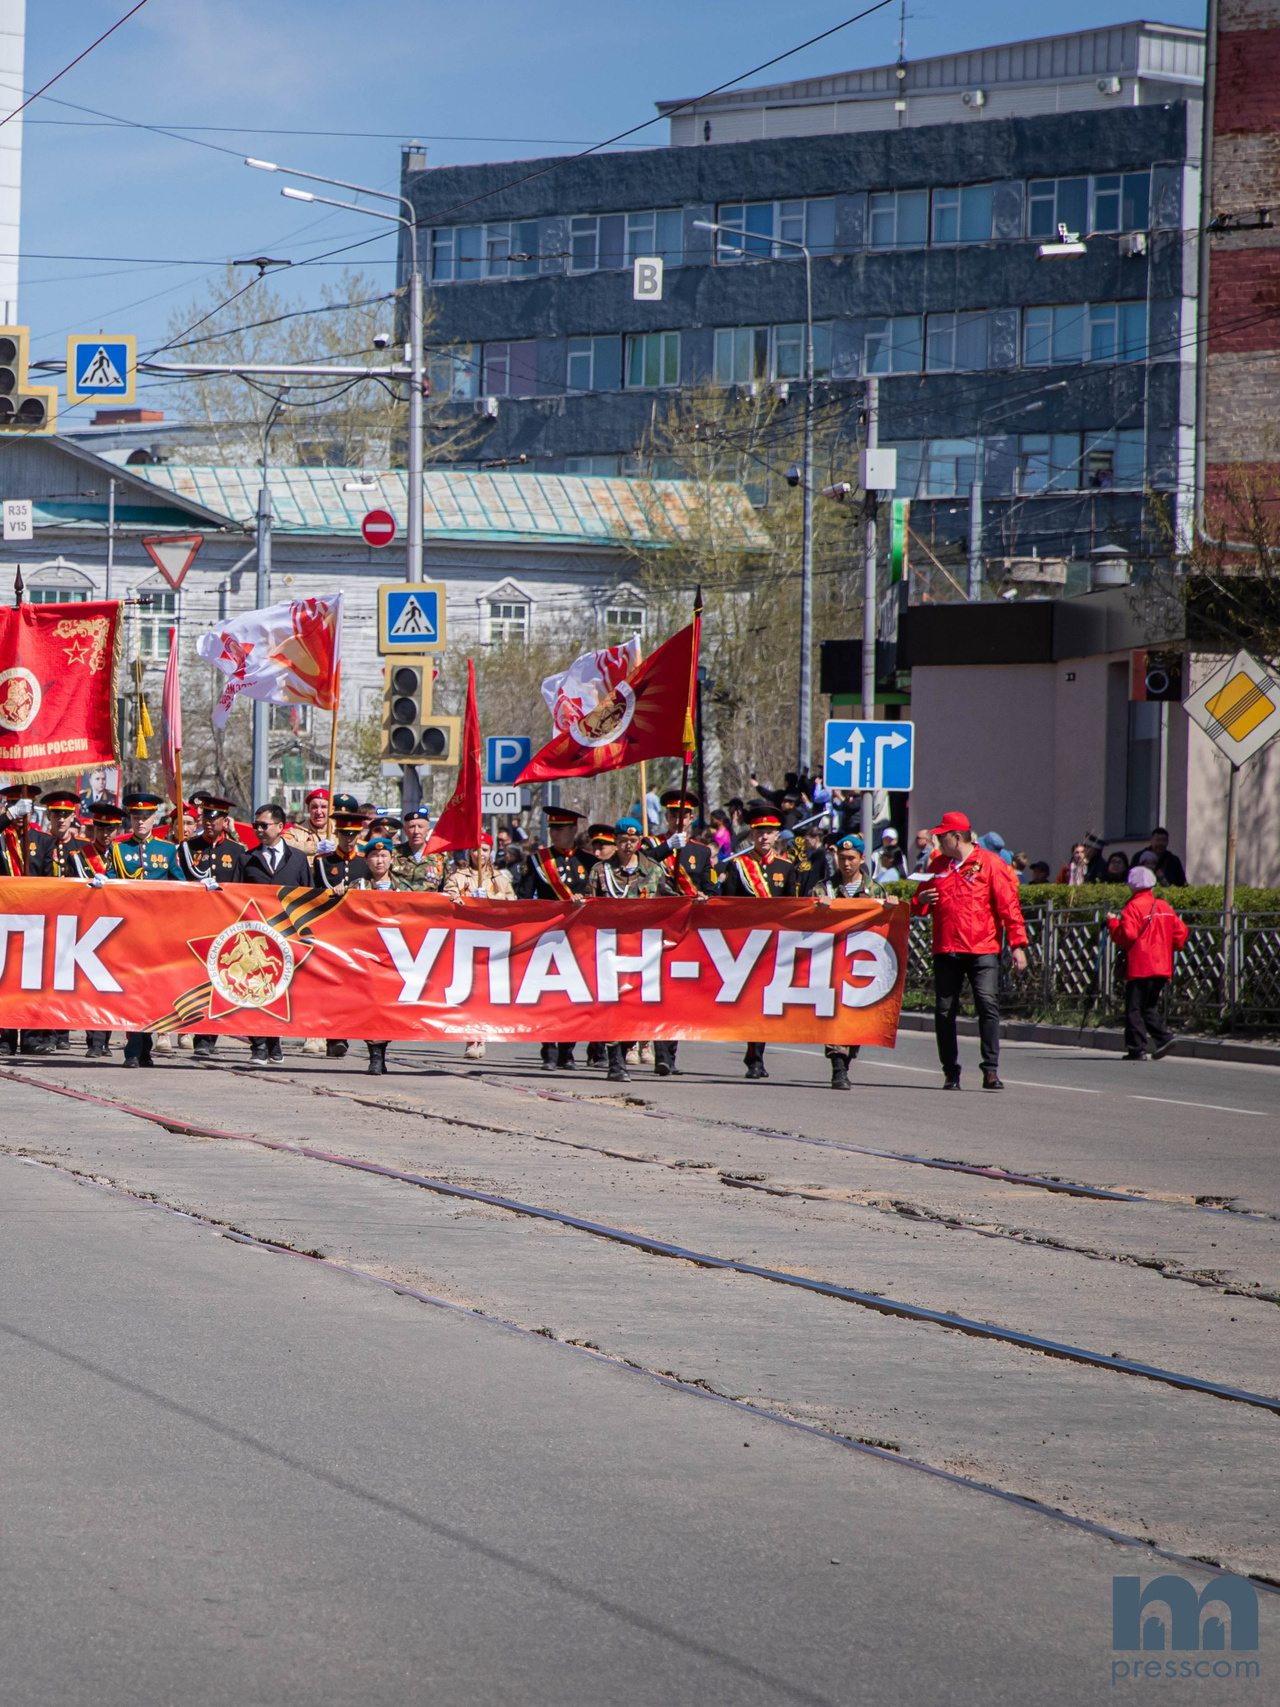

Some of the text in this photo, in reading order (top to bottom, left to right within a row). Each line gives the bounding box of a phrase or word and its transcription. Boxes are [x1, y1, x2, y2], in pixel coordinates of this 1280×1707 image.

[8, 505, 28, 516] R35
[10, 521, 27, 532] V15
[47, 738, 88, 755] РОССИИ
[482, 792, 517, 807] ТОП
[209, 922, 293, 982] БЕССМЕРТНЫЙ ПОЛК РОССИИ
[377, 927, 899, 1017] УЛАН-УДЭ
